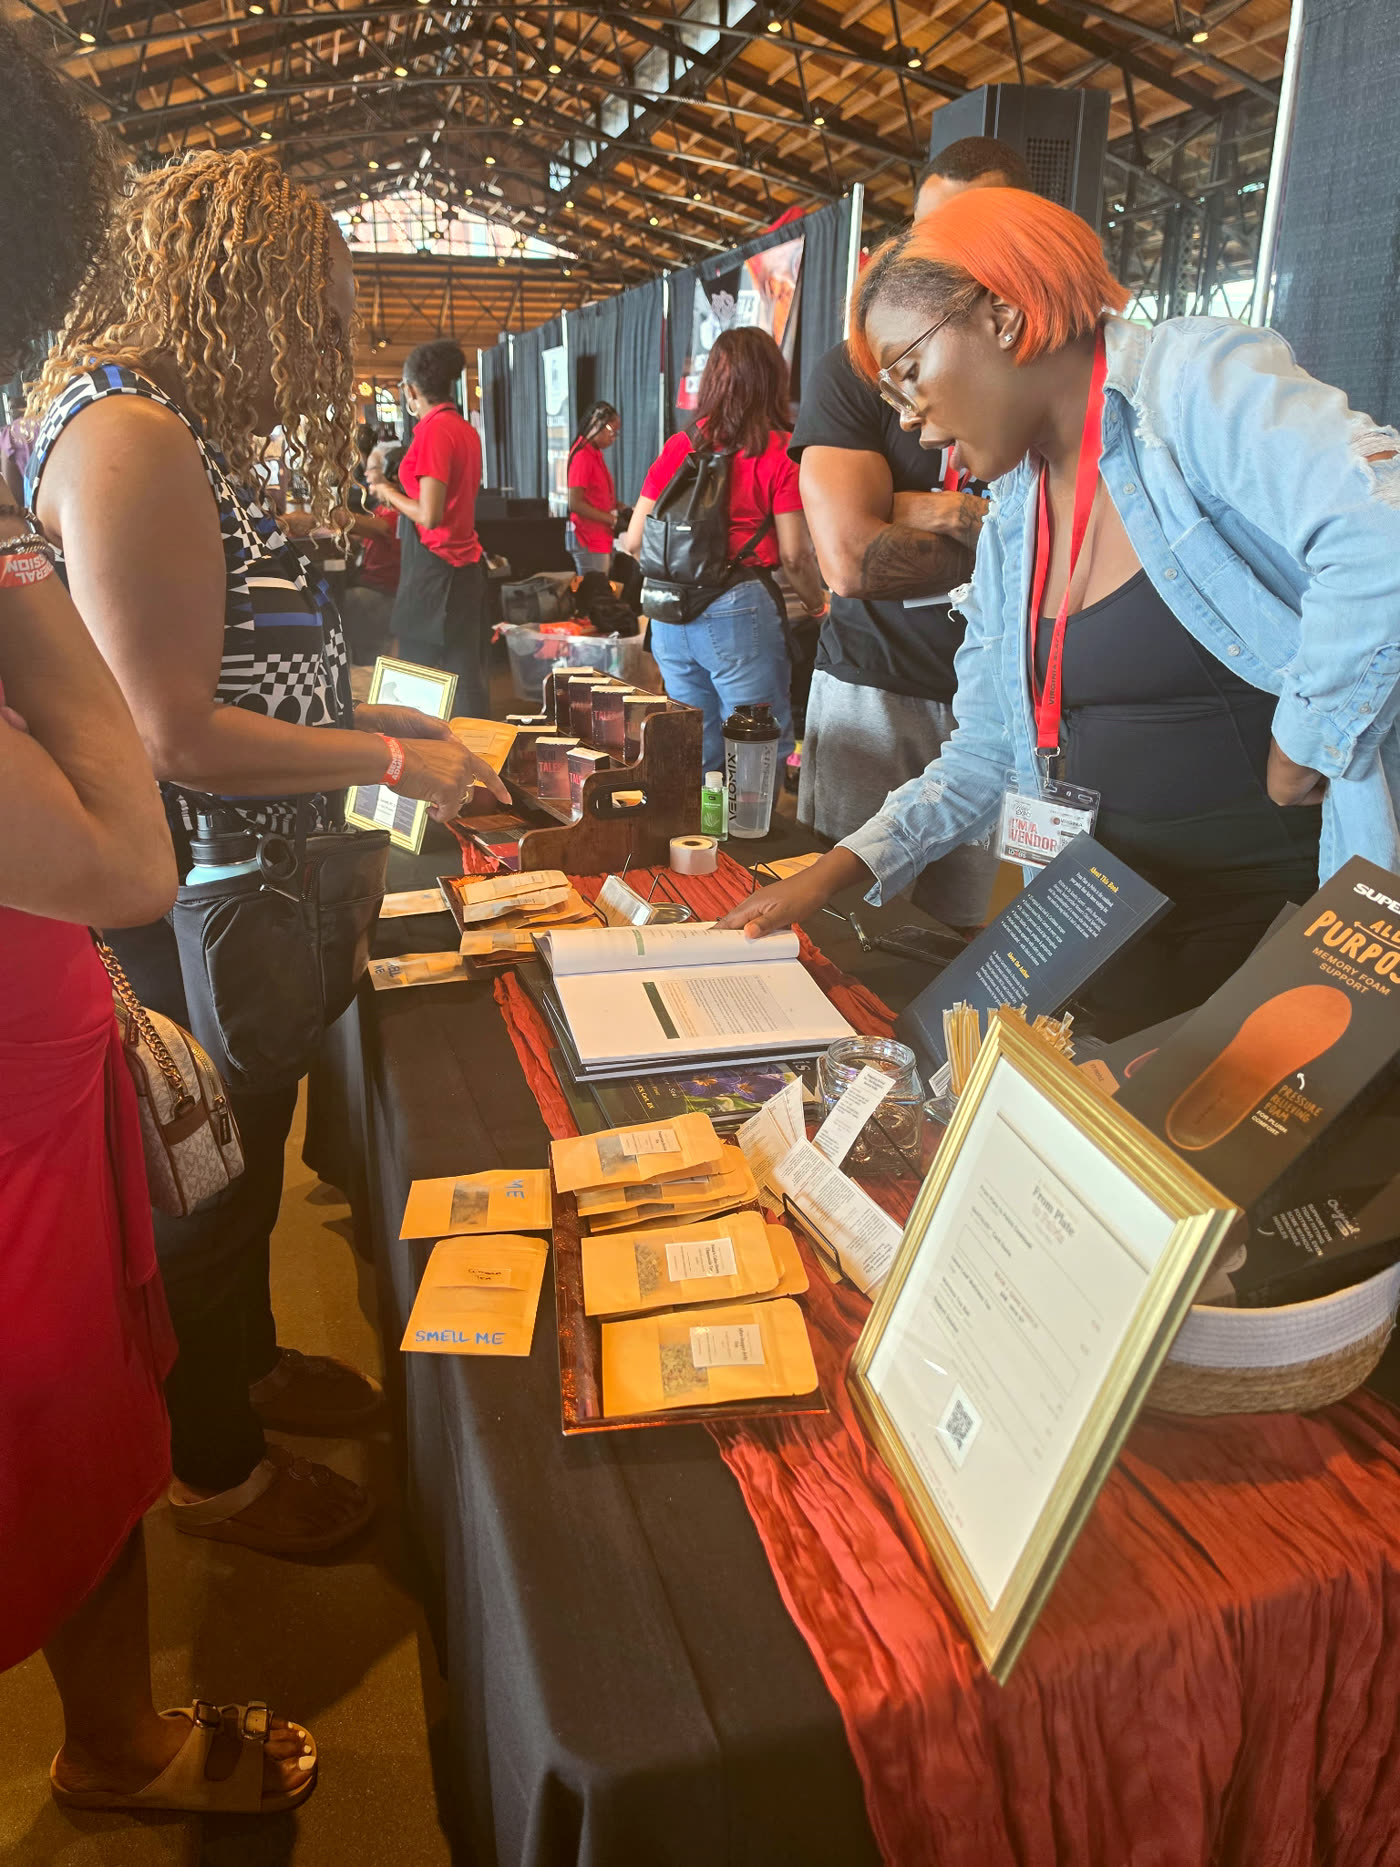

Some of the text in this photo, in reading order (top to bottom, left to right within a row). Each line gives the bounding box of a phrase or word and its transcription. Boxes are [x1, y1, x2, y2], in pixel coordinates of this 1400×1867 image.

[728, 753, 737, 821] VELOMIX
[1012, 818, 1028, 831] I'M
[1011, 829, 1057, 852] VENDOR
[1089, 865, 1120, 893] About This Book
[1312, 947, 1392, 996] MEMORY FOAM
[1319, 962, 1370, 994] SUPPORT
[1264, 1102, 1290, 1122] FOAM
[1270, 1094, 1311, 1123] RELIEVING
[1279, 1085, 1324, 1117] PRESSURE
[1251, 1115, 1280, 1136] COMFORT
[1256, 1110, 1288, 1134] FOR PLUSH
[505, 1179, 525, 1199] ME
[1032, 1185, 1053, 1213] From
[1279, 1213, 1301, 1246] REMOVABLE
[1300, 1206, 1324, 1243] TIGHT FITTING
[1327, 1200, 1360, 1233] Original
[1286, 1211, 1313, 1252] SOME WITHOUT
[1293, 1208, 1323, 1255] FOOTWEAR, EVEN
[1322, 1228, 1332, 1241] FOR
[415, 1330, 508, 1345] SMELL ME
